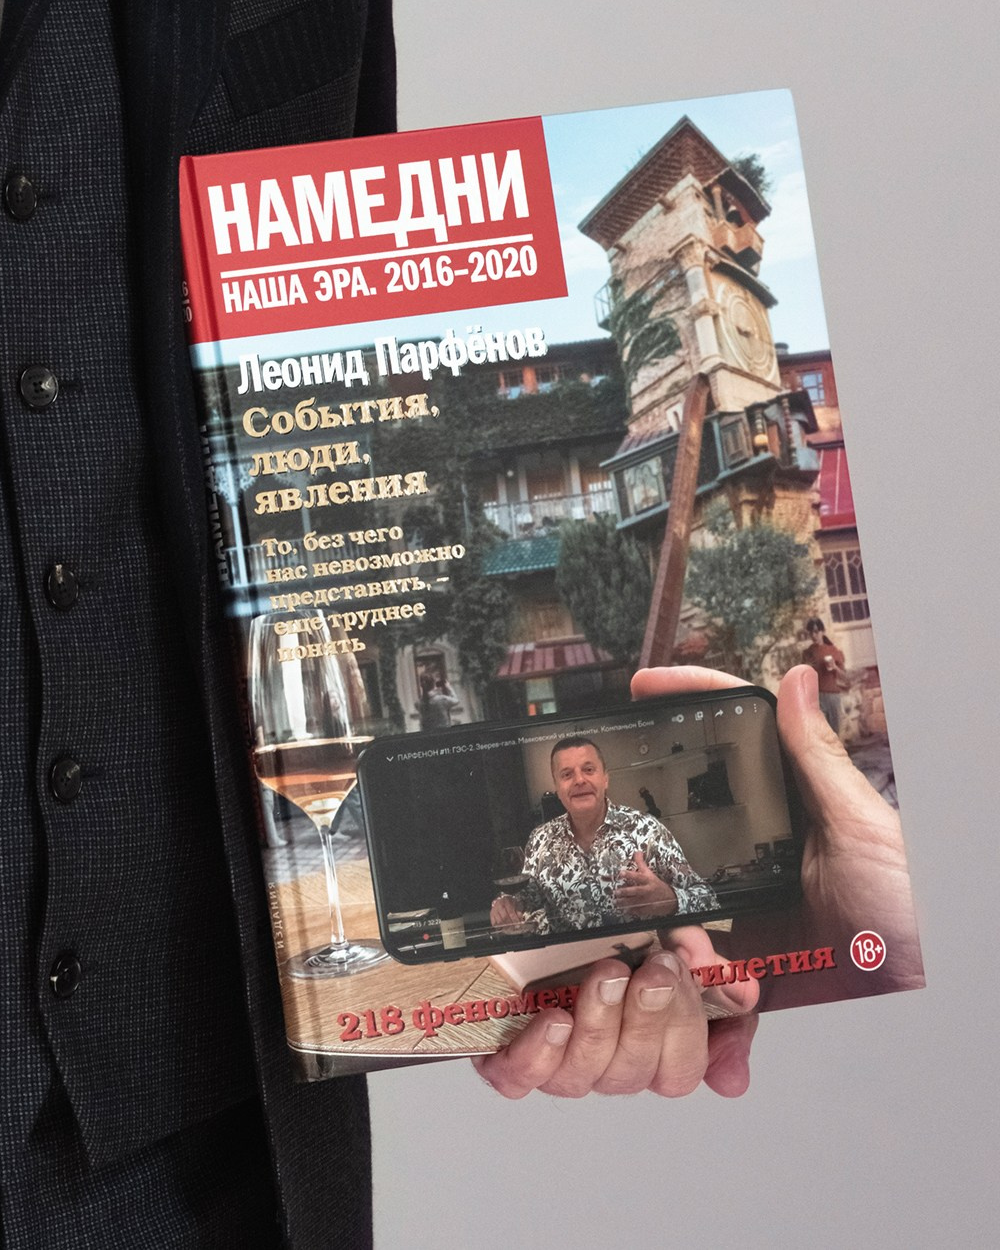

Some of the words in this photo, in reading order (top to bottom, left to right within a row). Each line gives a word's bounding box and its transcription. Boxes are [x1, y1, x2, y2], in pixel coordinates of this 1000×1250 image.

[207, 149, 530, 255] НАМЕДНИ
[221, 271, 308, 314] НАША
[314, 265, 377, 302] ЭРА.
[237, 348, 371, 395] Леонид
[374, 324, 549, 378] Парфёнов
[242, 392, 441, 438] События,
[249, 440, 371, 477] люди,
[254, 470, 430, 515] явления
[262, 538, 298, 557] То,
[304, 530, 344, 552] без
[348, 525, 403, 545] чего
[265, 565, 308, 583] нас
[312, 543, 466, 577] невозможно
[269, 574, 432, 612] представить,
[273, 617, 323, 637] еще
[327, 602, 426, 631] труднее
[277, 637, 366, 662] понять
[397, 749, 439, 761] ПАРФЕНОН
[518, 733, 557, 744] Маяковский
[600, 723, 636, 733] Компаньон
[267, 881, 285, 949] ИЗДАНИЯ
[854, 938, 883, 964] 18+
[336, 1005, 405, 1042] 218
